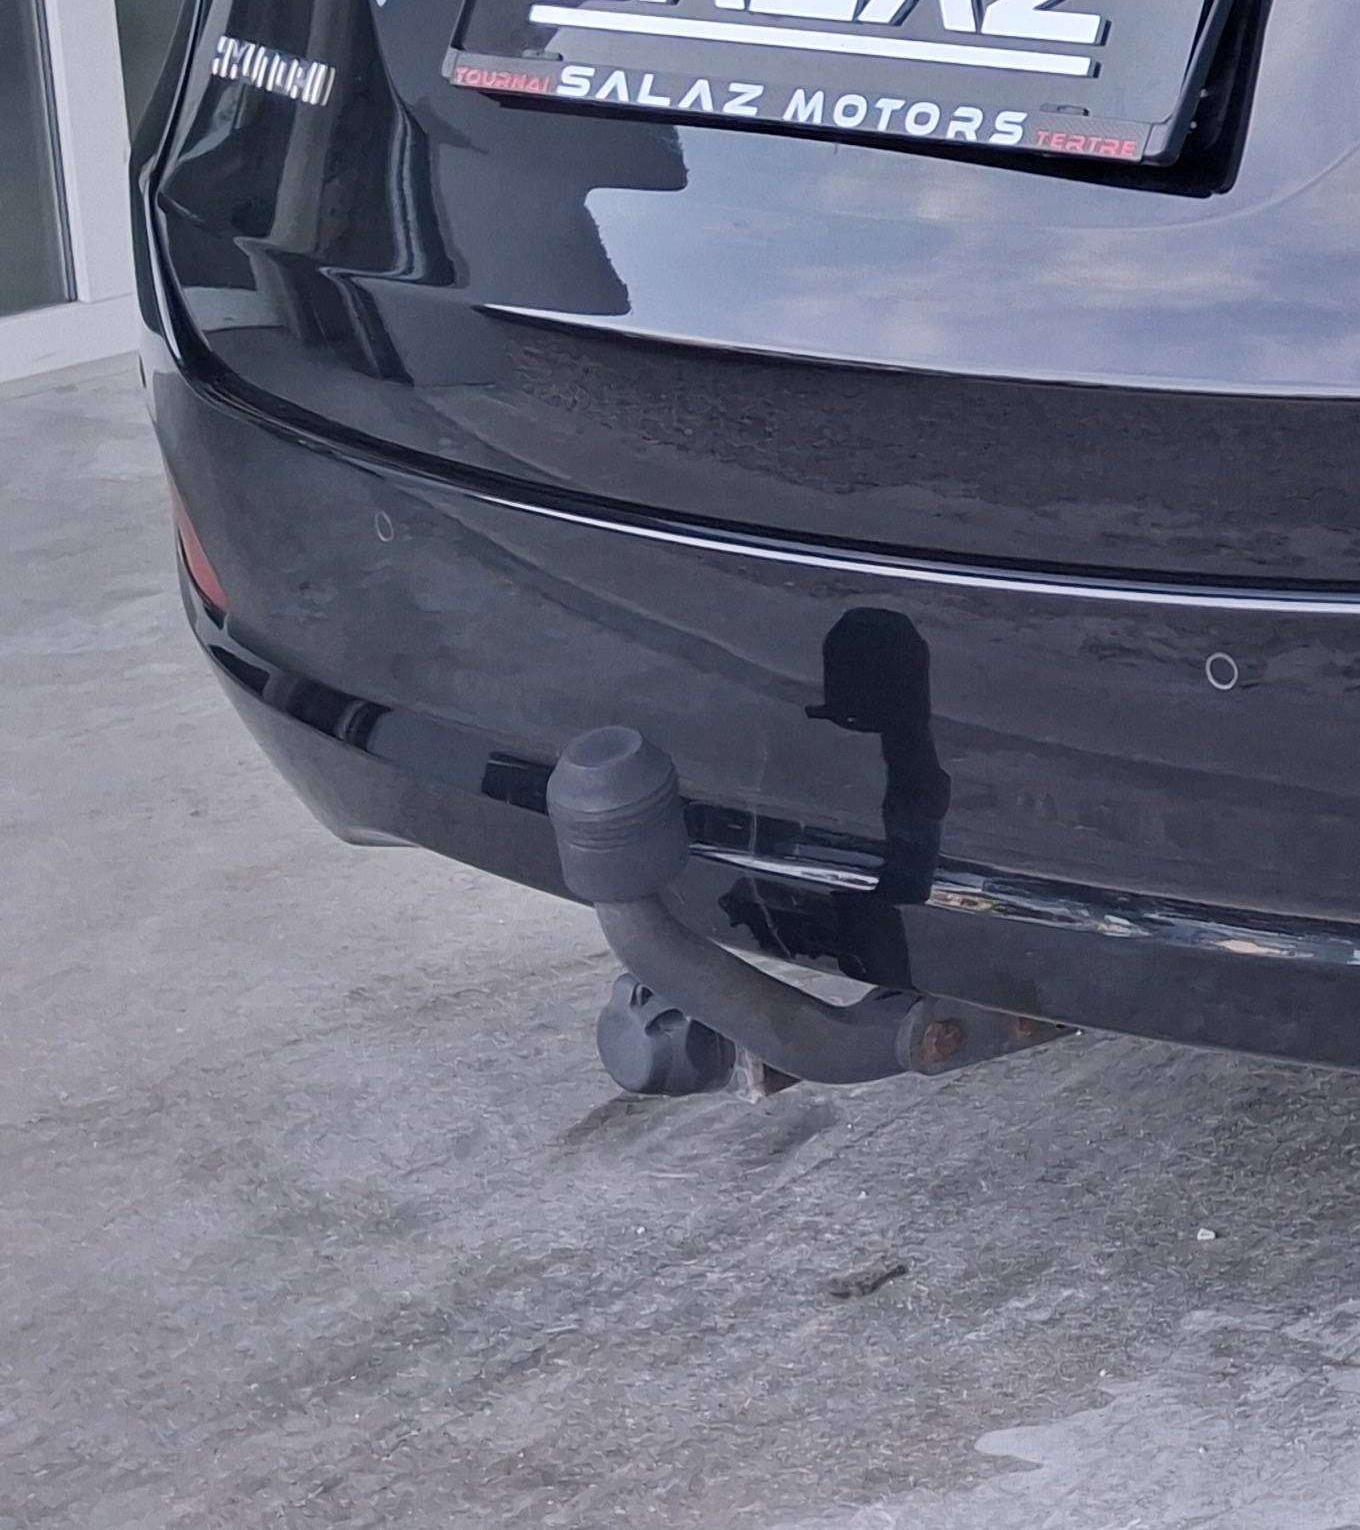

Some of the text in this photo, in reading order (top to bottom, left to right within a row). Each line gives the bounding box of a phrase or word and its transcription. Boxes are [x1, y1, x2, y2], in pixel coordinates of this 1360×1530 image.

[455, 65, 1137, 157] TOURNAI SALAZ MOTORS TERTRE
